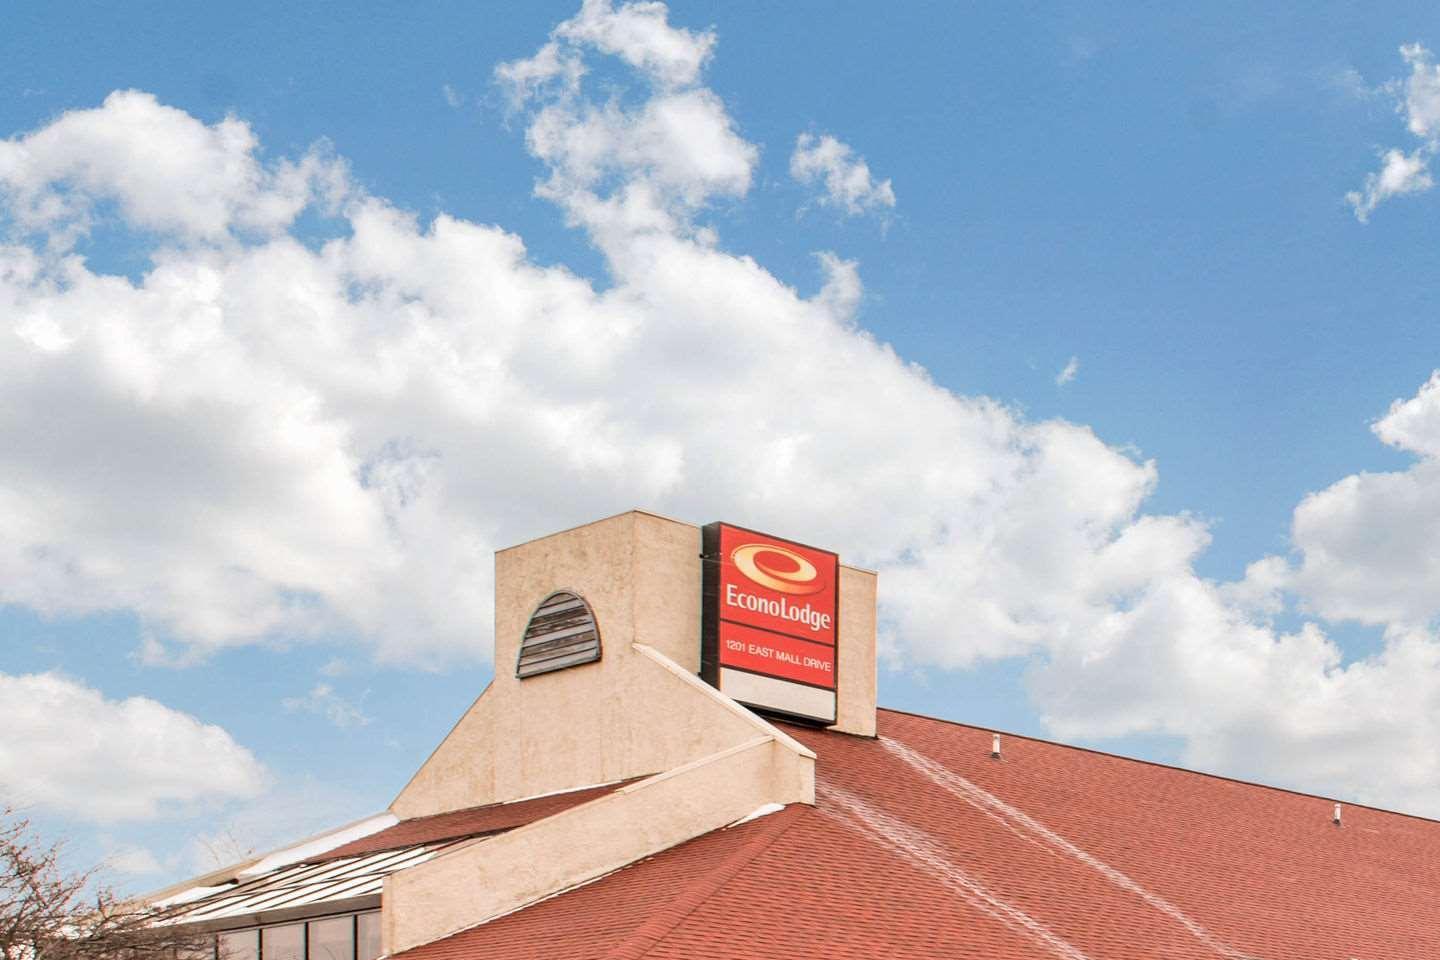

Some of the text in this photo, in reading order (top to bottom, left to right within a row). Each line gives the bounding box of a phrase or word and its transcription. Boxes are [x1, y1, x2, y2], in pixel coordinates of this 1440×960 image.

[726, 583, 831, 631] EconoLodge
[726, 639, 831, 672] 1201 EAST MALL DRIVE
